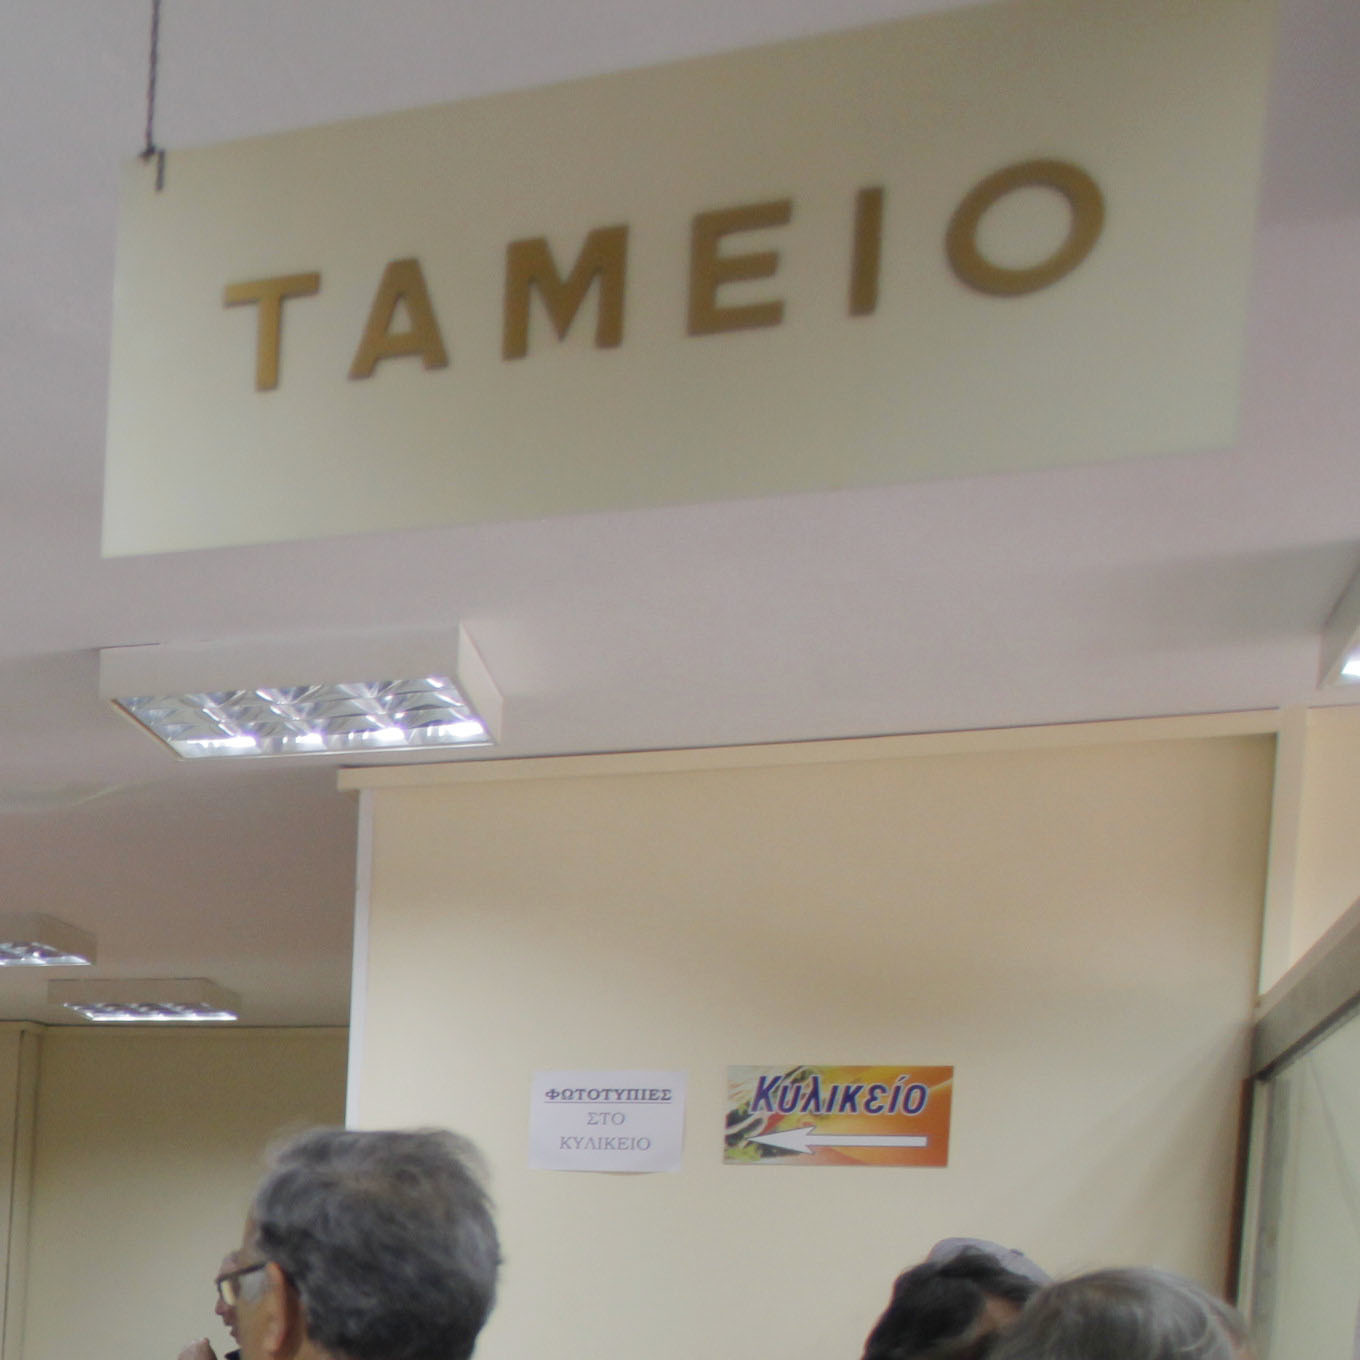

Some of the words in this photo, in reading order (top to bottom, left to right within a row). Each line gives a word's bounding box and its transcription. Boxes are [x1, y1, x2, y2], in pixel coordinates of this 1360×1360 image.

[222, 157, 1107, 394] ΤΑΜΕΙΟ
[544, 1087, 672, 1102] ΦΩΤΟΤΥΠΙΕΣ
[750, 1073, 930, 1116] Κυλικείο
[586, 1111, 626, 1126] ΣΤΟ
[559, 1135, 652, 1152] ΚΥΛΙΚΕΙΟ
